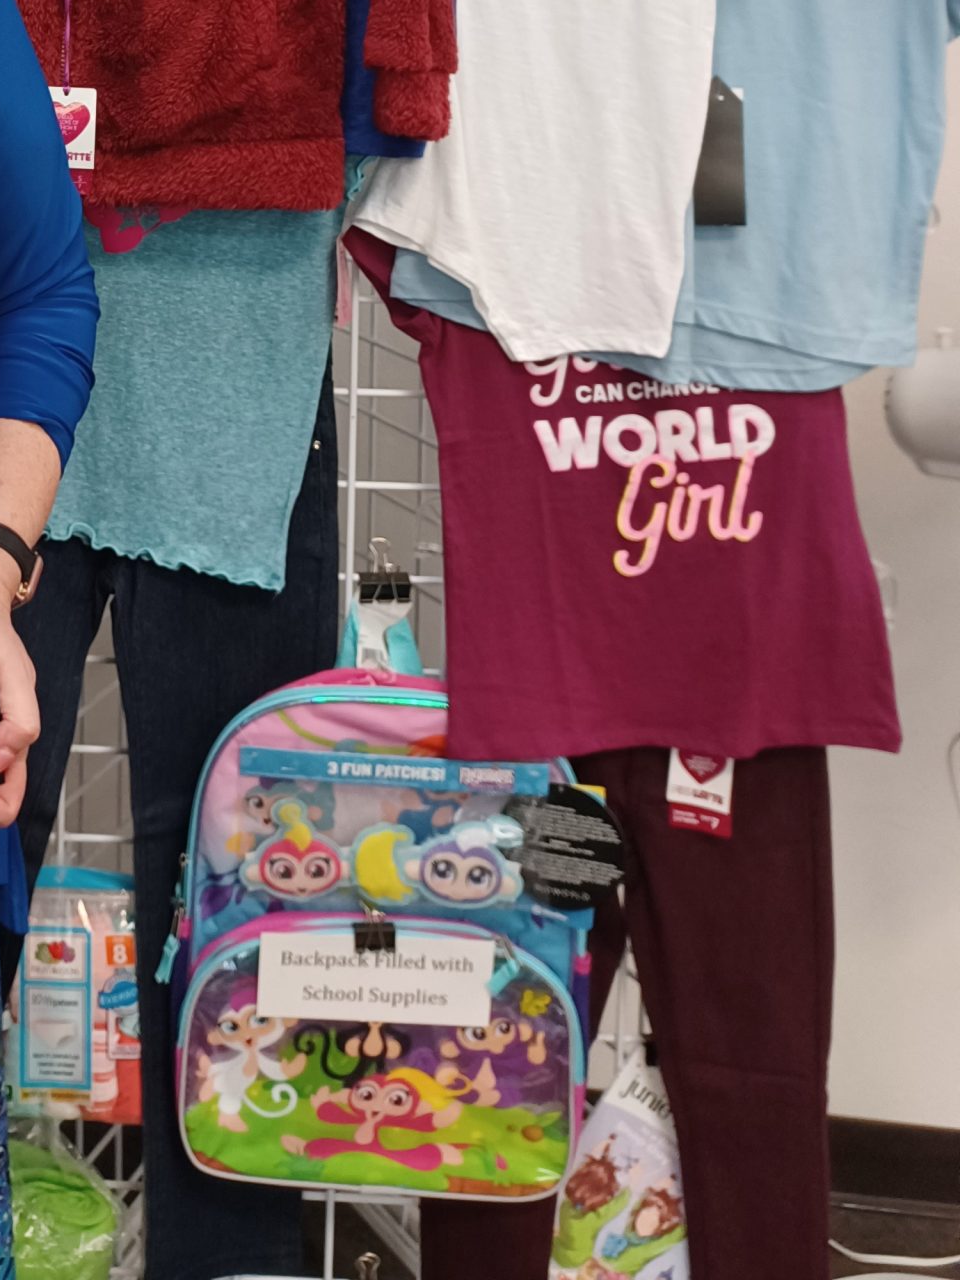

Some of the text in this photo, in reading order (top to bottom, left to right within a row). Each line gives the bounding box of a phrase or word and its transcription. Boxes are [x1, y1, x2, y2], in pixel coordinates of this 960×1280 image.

[574, 383, 625, 404] CAN
[533, 403, 776, 472] WORLD
[613, 450, 764, 577] Girl
[327, 761, 338, 776] 3
[341, 762, 373, 778] FUN
[113, 942, 129, 965] 8
[280, 949, 475, 972] Backpack Filled with
[302, 984, 449, 1007] School Supplies
